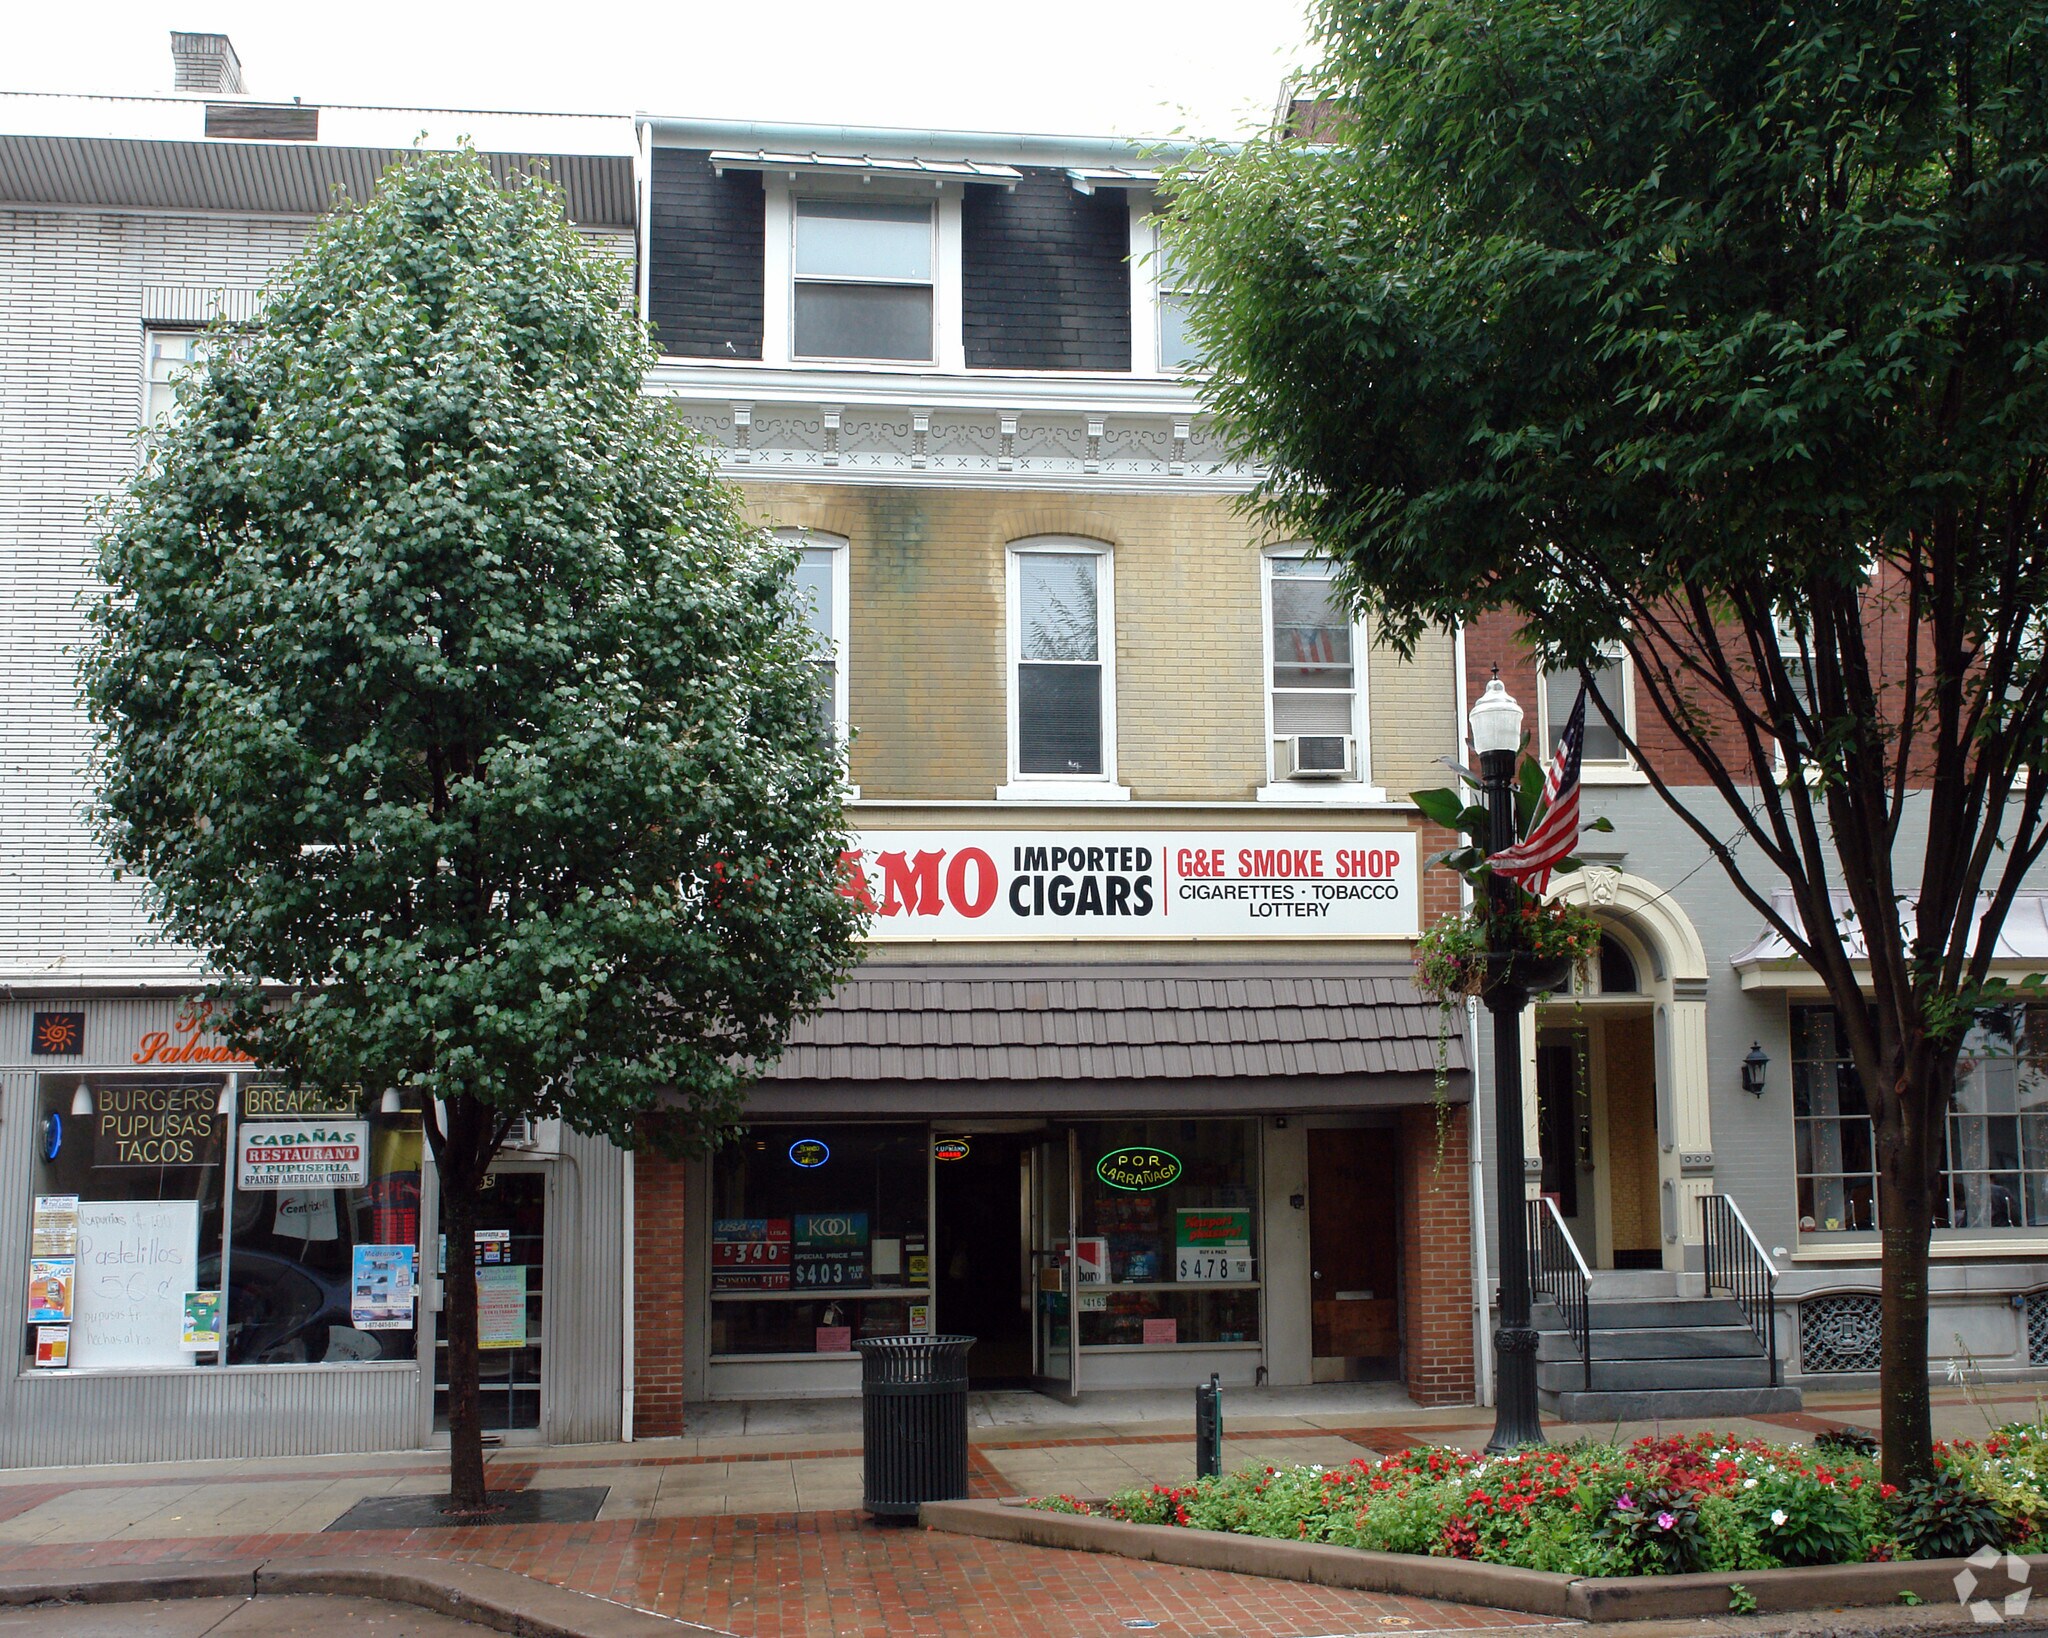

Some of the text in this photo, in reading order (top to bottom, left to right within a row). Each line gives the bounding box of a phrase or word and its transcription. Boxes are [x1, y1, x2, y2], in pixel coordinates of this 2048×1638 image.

[1013, 846, 1152, 873] IMPORTED
[1177, 848, 1400, 878] G&E SMOKE SHOP
[1009, 874, 1153, 917] CIGARS
[1179, 885, 1399, 901] CIGARETTES TOBACCO
[1249, 902, 1330, 917] LOTTERY
[99, 1089, 215, 1112] BURGERS
[101, 1114, 212, 1137] PUPUSAS
[249, 1128, 357, 1146] CABAÑAS
[115, 1140, 194, 1163] TACOS
[248, 1147, 358, 1162] RESTAURANT
[265, 1163, 351, 1173] PUPUSERIA
[1118, 1155, 1161, 1167] POR
[244, 1172, 360, 1185] SPANISH AMERICAN CUISINE
[1101, 1162, 1177, 1186] LARRAÑAGA
[808, 1218, 857, 1236] KOOL
[76, 1236, 183, 1266] Pastelillos
[794, 1253, 824, 1261] SPECIAL
[826, 1252, 849, 1260] PRICE
